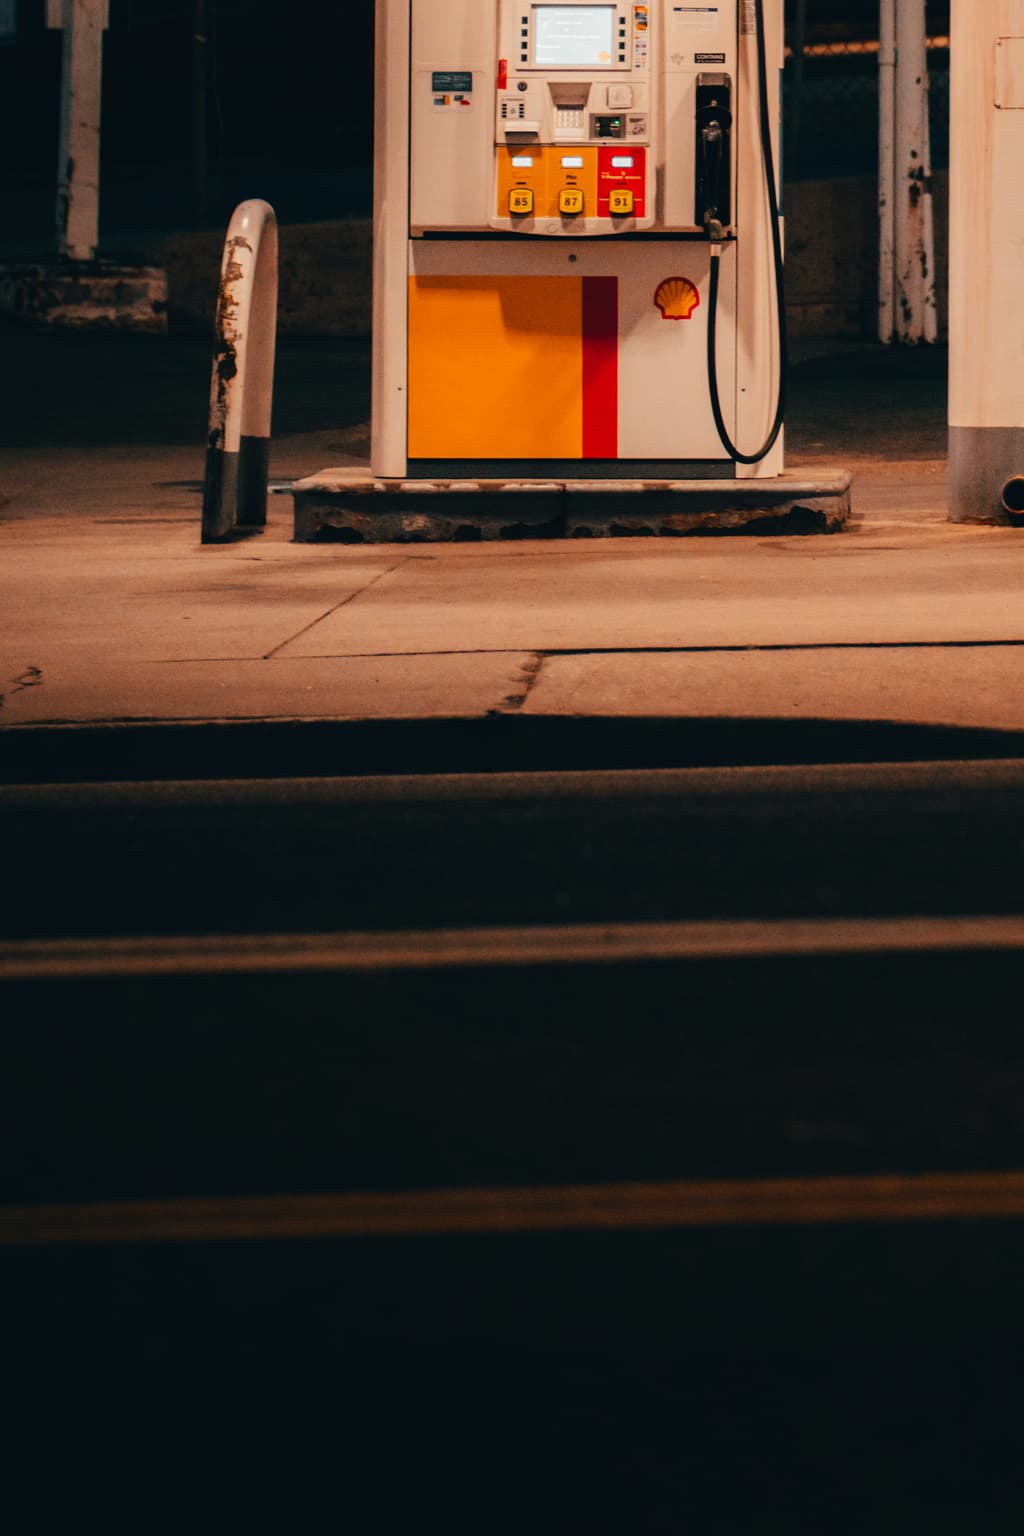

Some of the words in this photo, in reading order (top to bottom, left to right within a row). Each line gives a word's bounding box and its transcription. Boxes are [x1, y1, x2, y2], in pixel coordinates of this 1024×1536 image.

[514, 197, 528, 207] 85
[564, 197, 578, 207] 87
[614, 197, 628, 207] 91
